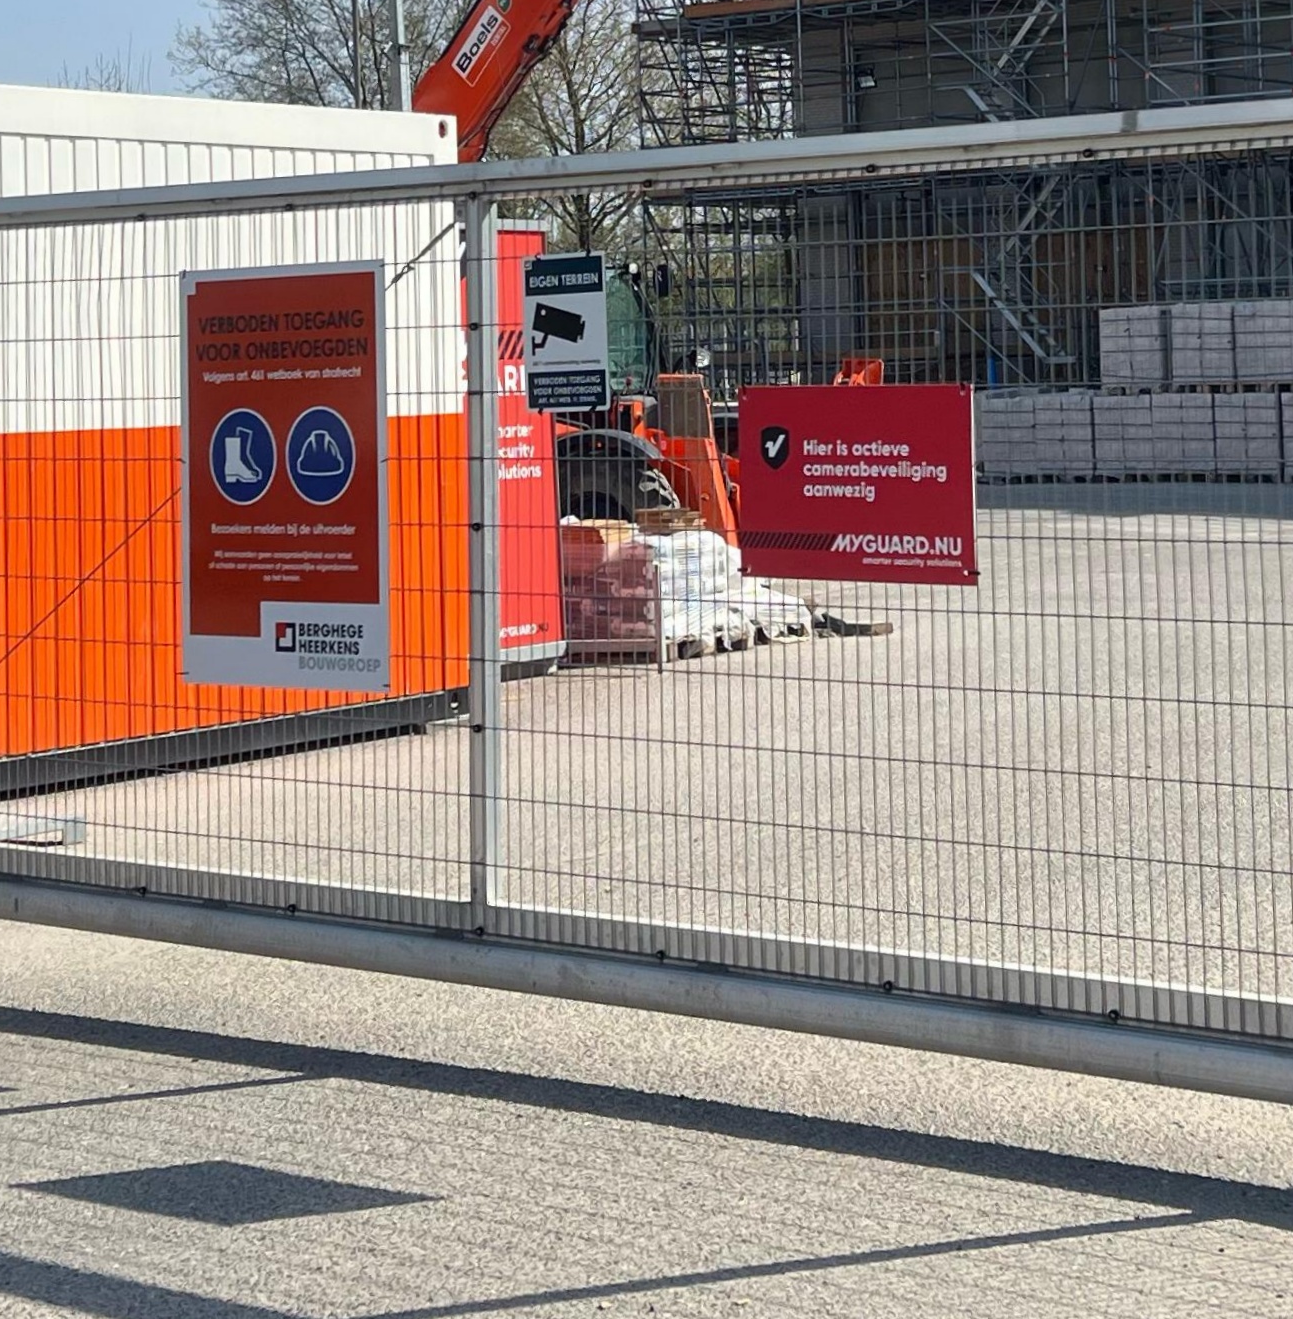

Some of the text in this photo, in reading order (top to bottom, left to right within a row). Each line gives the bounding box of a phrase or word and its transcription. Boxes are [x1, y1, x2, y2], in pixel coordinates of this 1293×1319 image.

[455, 14, 499, 74] Boels
[529, 272, 599, 288] EIGEN TERREIN
[198, 309, 365, 335] VERBODEN TOEGANG
[196, 337, 368, 361] VOOR ONBEVOEGDEN
[305, 369, 321, 379] van
[802, 439, 910, 457] Hier is actieve
[802, 461, 948, 482] camerabeveiliging
[802, 481, 876, 502] aanwezig
[298, 523, 311, 535] de
[830, 533, 963, 556] MYGUARD.NU
[298, 622, 364, 639] BERGHEGE
[298, 639, 360, 656] HEERKENS
[298, 655, 381, 673] BOUWGROEP
